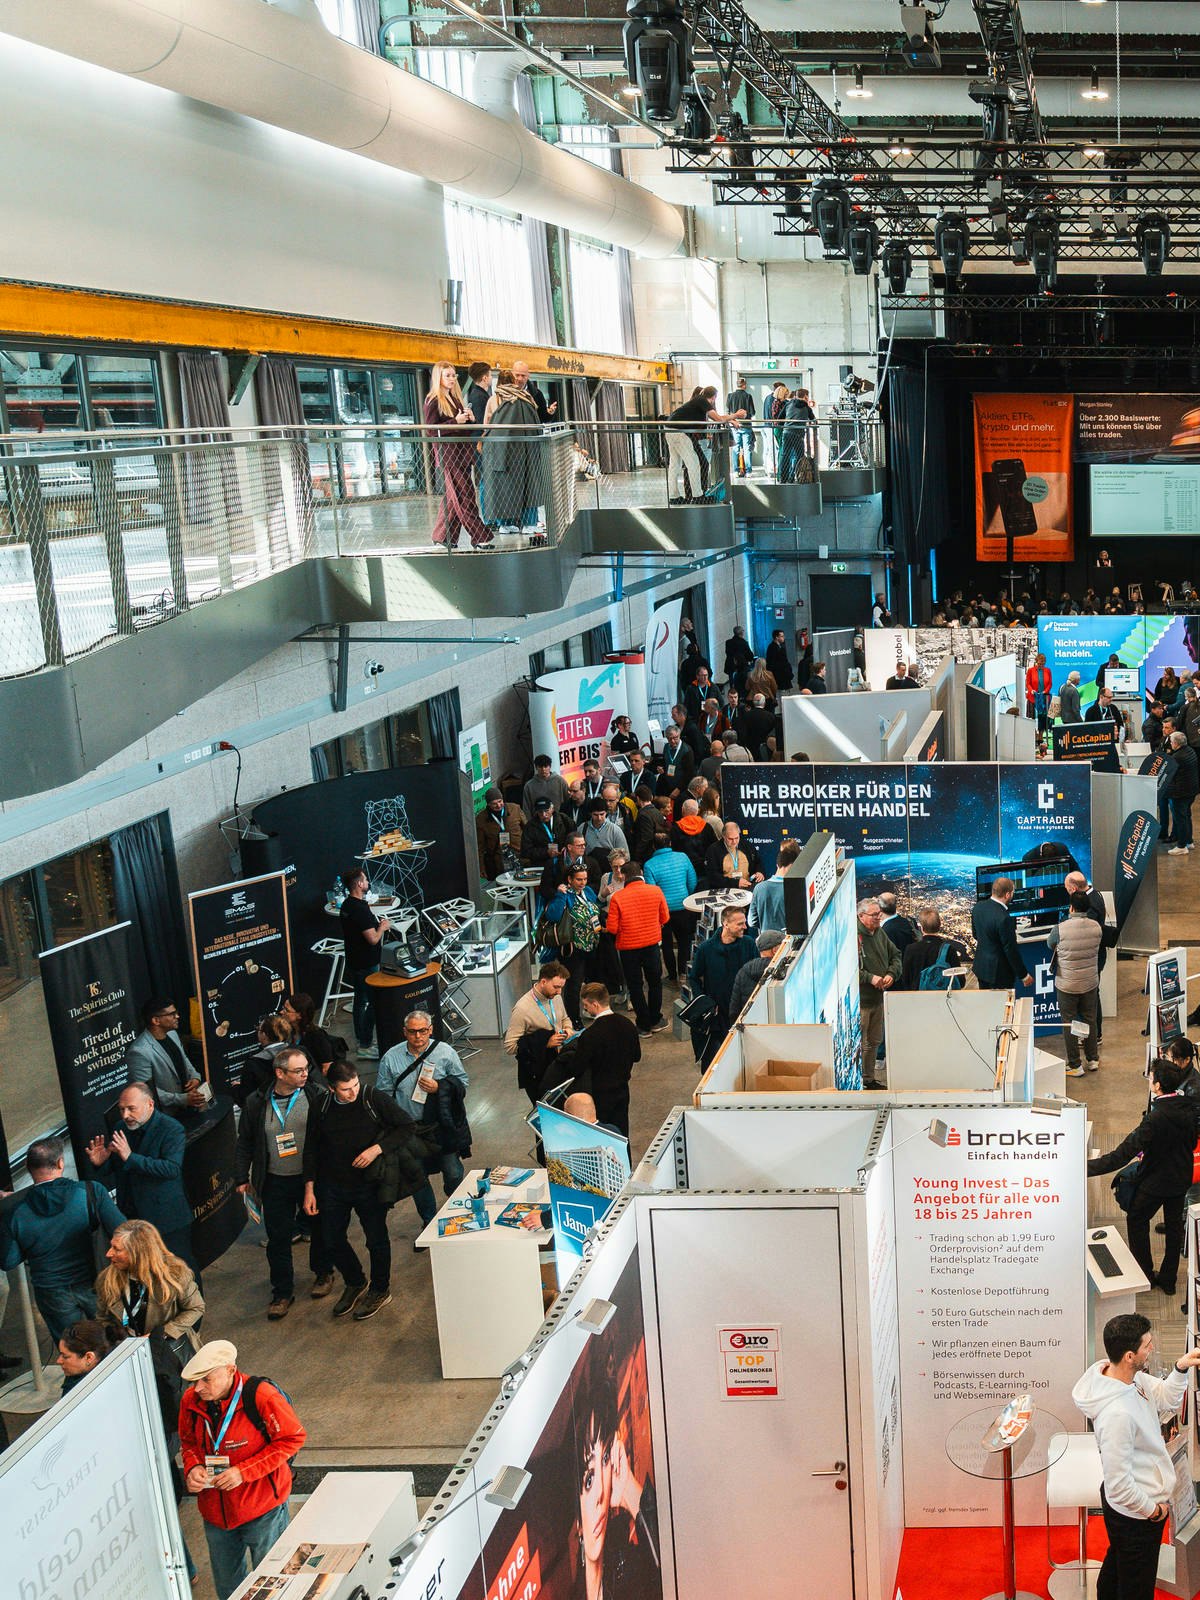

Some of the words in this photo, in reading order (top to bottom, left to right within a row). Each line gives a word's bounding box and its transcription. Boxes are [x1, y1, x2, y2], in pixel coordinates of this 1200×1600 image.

[1080, 413, 1096, 421] Über
[980, 423, 1009, 432] Krypto
[1011, 423, 1029, 431] und
[1031, 423, 1056, 431] mehr.
[1106, 422, 1131, 430] können
[1133, 422, 1144, 430] Sie
[1146, 422, 1162, 430] über
[1054, 650, 1093, 658] Handeln.
[1072, 733, 1111, 743] CatCapital
[740, 784, 770, 799] IHR
[778, 784, 851, 799] BROKER
[855, 781, 891, 799] FÜR
[895, 784, 932, 799] DEN
[740, 802, 855, 818] WELTWEITEN
[859, 802, 931, 817] HANDEL
[1017, 816, 1075, 824] CAPTRADER
[1123, 815, 1145, 860] CatCapital
[69, 1006, 83, 1019] The
[82, 996, 108, 1013] Spirits
[107, 988, 125, 1002] Club
[82, 1027, 110, 1049] Tired
[112, 1021, 122, 1036] of
[73, 1046, 99, 1067] stock
[100, 1030, 136, 1054] market
[87, 1046, 126, 1073] swings?
[967, 1129, 1065, 1146] broker
[967, 1151, 1009, 1160] Einfach
[1013, 1151, 1058, 1160] handeln
[913, 1177, 959, 1191] Young
[963, 1177, 1008, 1188] Invest
[1023, 1177, 1050, 1188] Das
[913, 1193, 975, 1207] Angebot
[979, 1193, 1000, 1204] für
[1004, 1193, 1029, 1204] alle
[1033, 1194, 1060, 1203] von
[915, 1209, 932, 1220] 18
[936, 1209, 957, 1220] bis
[961, 1209, 979, 1220] 25
[983, 1209, 1032, 1220] Jahren
[929, 1234, 965, 1245] Trading
[967, 1233, 994, 1242] schon
[997, 1233, 1009, 1242] ab
[1012, 1233, 1031, 1243] 1,99
[1034, 1233, 1055, 1242] Euro
[1006, 1244, 1021, 1253] auf
[1023, 1244, 1044, 1253] dem
[930, 1255, 991, 1266] Handelsplatz
[994, 1255, 1039, 1266] Tradegate
[930, 1266, 975, 1277] Exchange
[931, 1287, 982, 1296] Kostenlose
[984, 1286, 1050, 1298] Depotführung
[931, 1308, 943, 1317] 50
[945, 1308, 967, 1317] Euro
[969, 1308, 1015, 1317] Gutschein
[1018, 1307, 1040, 1316] nach
[1042, 1307, 1063, 1316] dem
[932, 1318, 961, 1327] ersten
[964, 1318, 989, 1327] Trade
[932, 1339, 948, 1348] Wir
[950, 1339, 989, 1351] pflanzen
[992, 1339, 1017, 1348] einen
[1020, 1339, 1046, 1348] Baum
[1048, 1338, 1061, 1347] für
[932, 1350, 957, 1360] jedes
[960, 1350, 1001, 1359] eröffnete
[1004, 1350, 1032, 1360] Depot
[736, 1356, 765, 1366] TOP
[933, 1370, 996, 1379] Börsenwissen
[998, 1370, 1025, 1379] durch
[934, 1381, 976, 1390] Podcasts,
[979, 1380, 1049, 1391] E-Learning-Tool
[934, 1391, 951, 1399] und
[954, 1391, 1016, 1399] Webseminare
